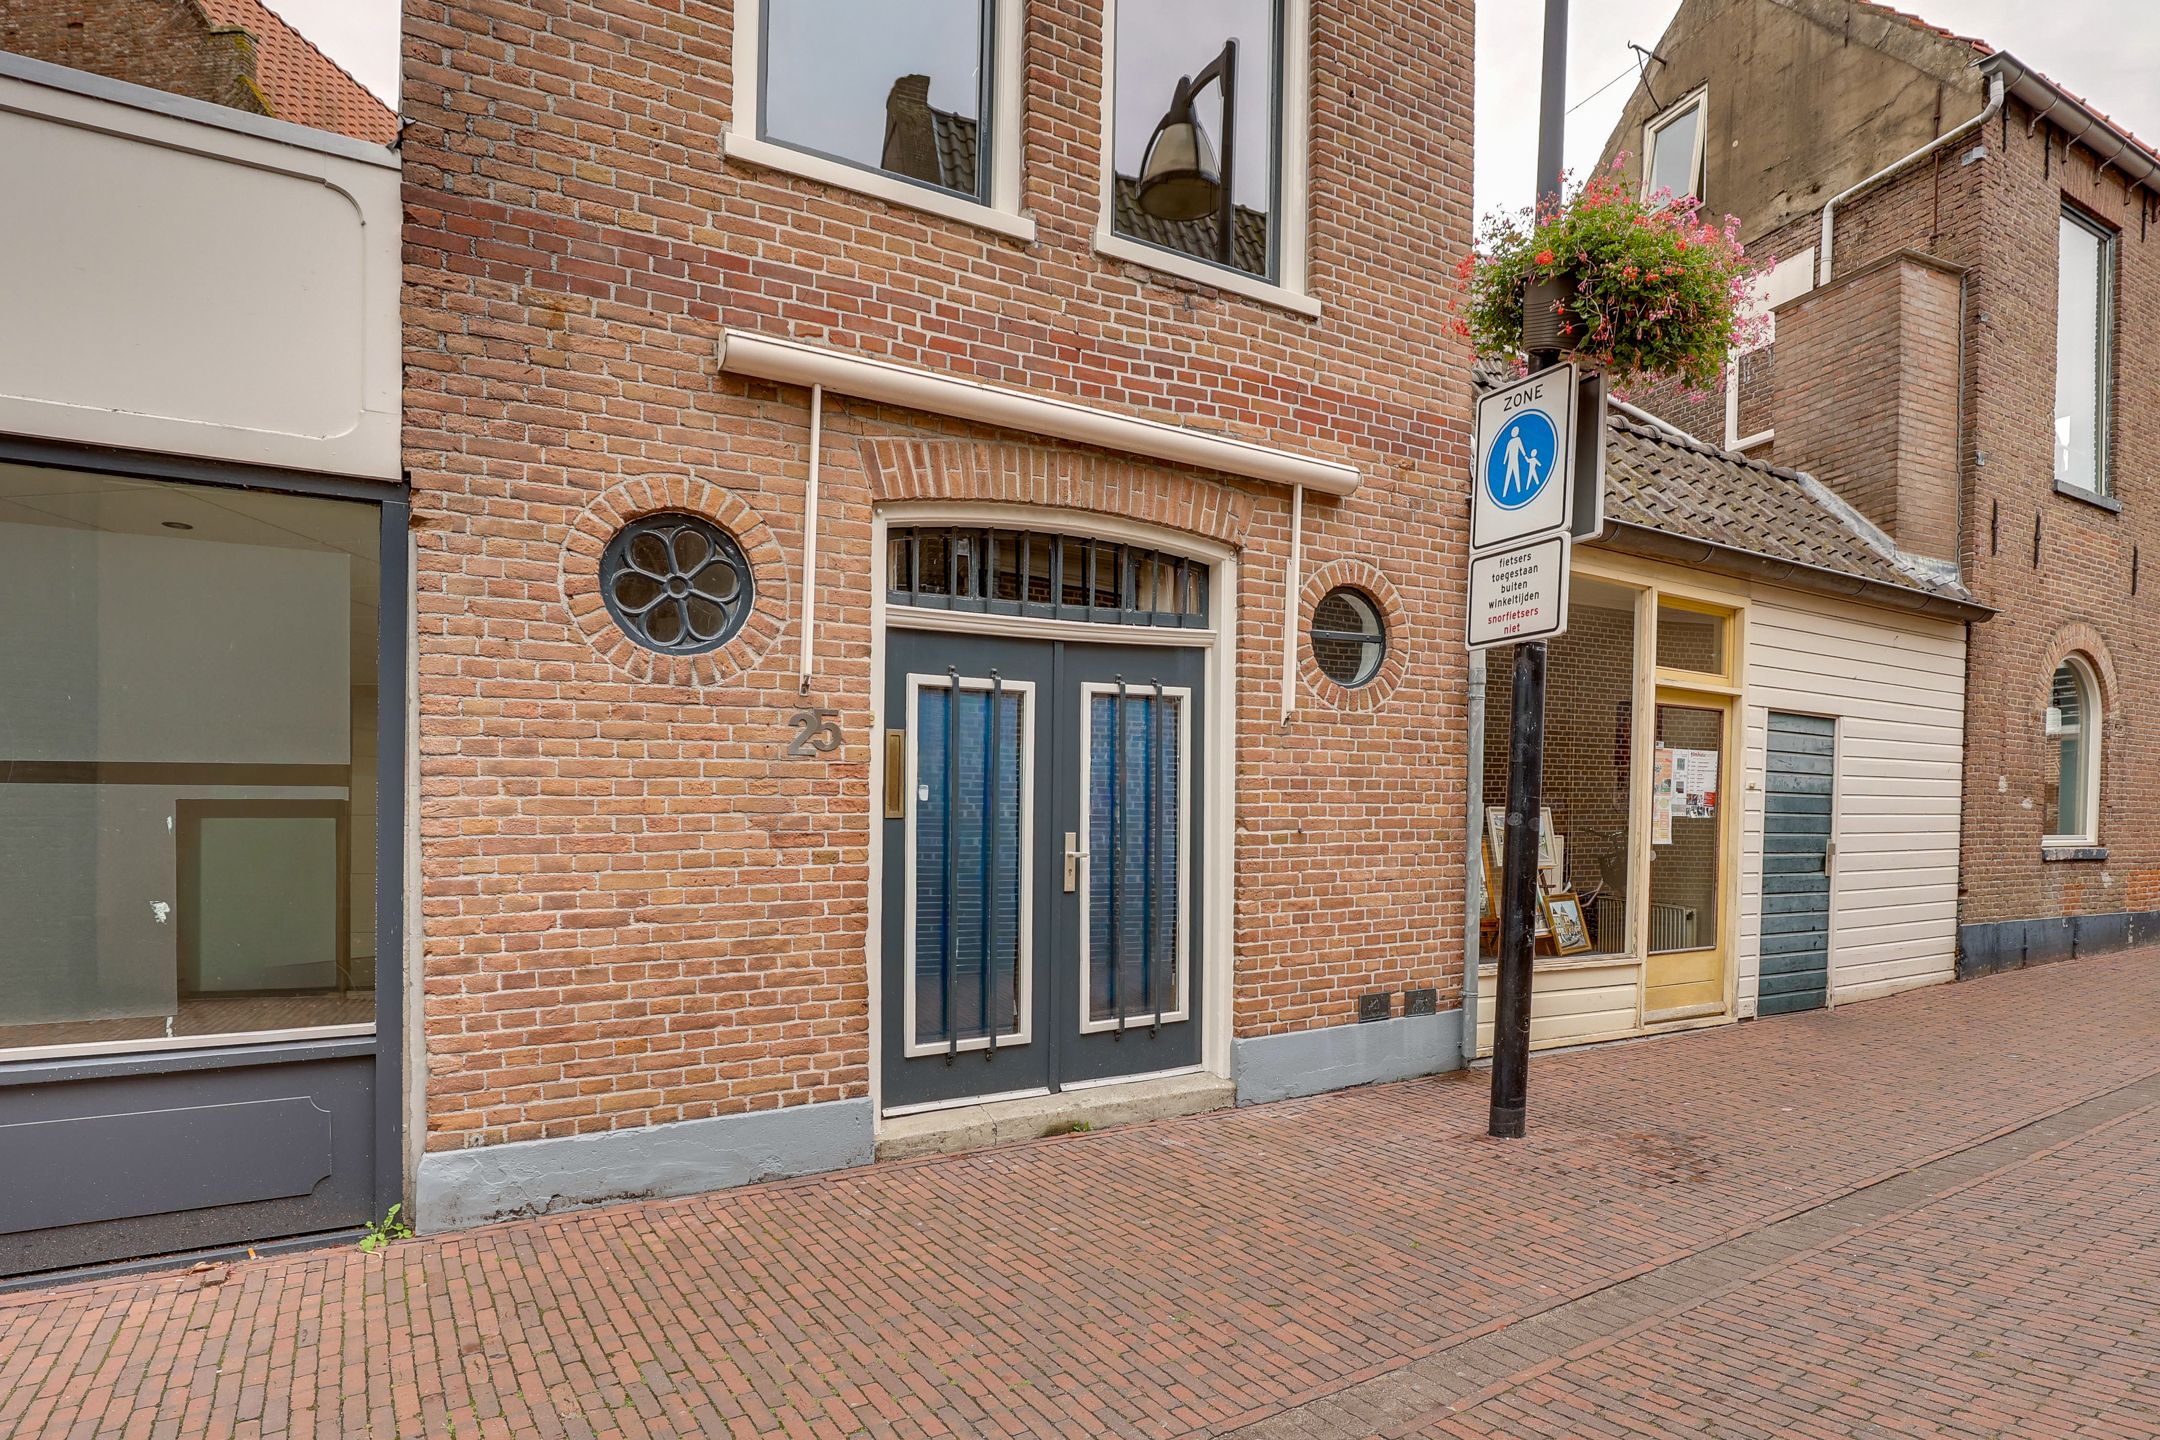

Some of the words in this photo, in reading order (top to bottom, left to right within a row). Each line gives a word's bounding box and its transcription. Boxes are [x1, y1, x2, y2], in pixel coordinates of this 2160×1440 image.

[1503, 384, 1544, 412] ZONE
[1499, 553, 1532, 568] fietsers
[1492, 564, 1538, 582] toegestaan
[1501, 581, 1528, 593] buiten
[1488, 591, 1540, 609] winkeltijden
[1488, 607, 1539, 625] snorfietsers
[1503, 623, 1520, 634] niet
[787, 709, 843, 757] 25
